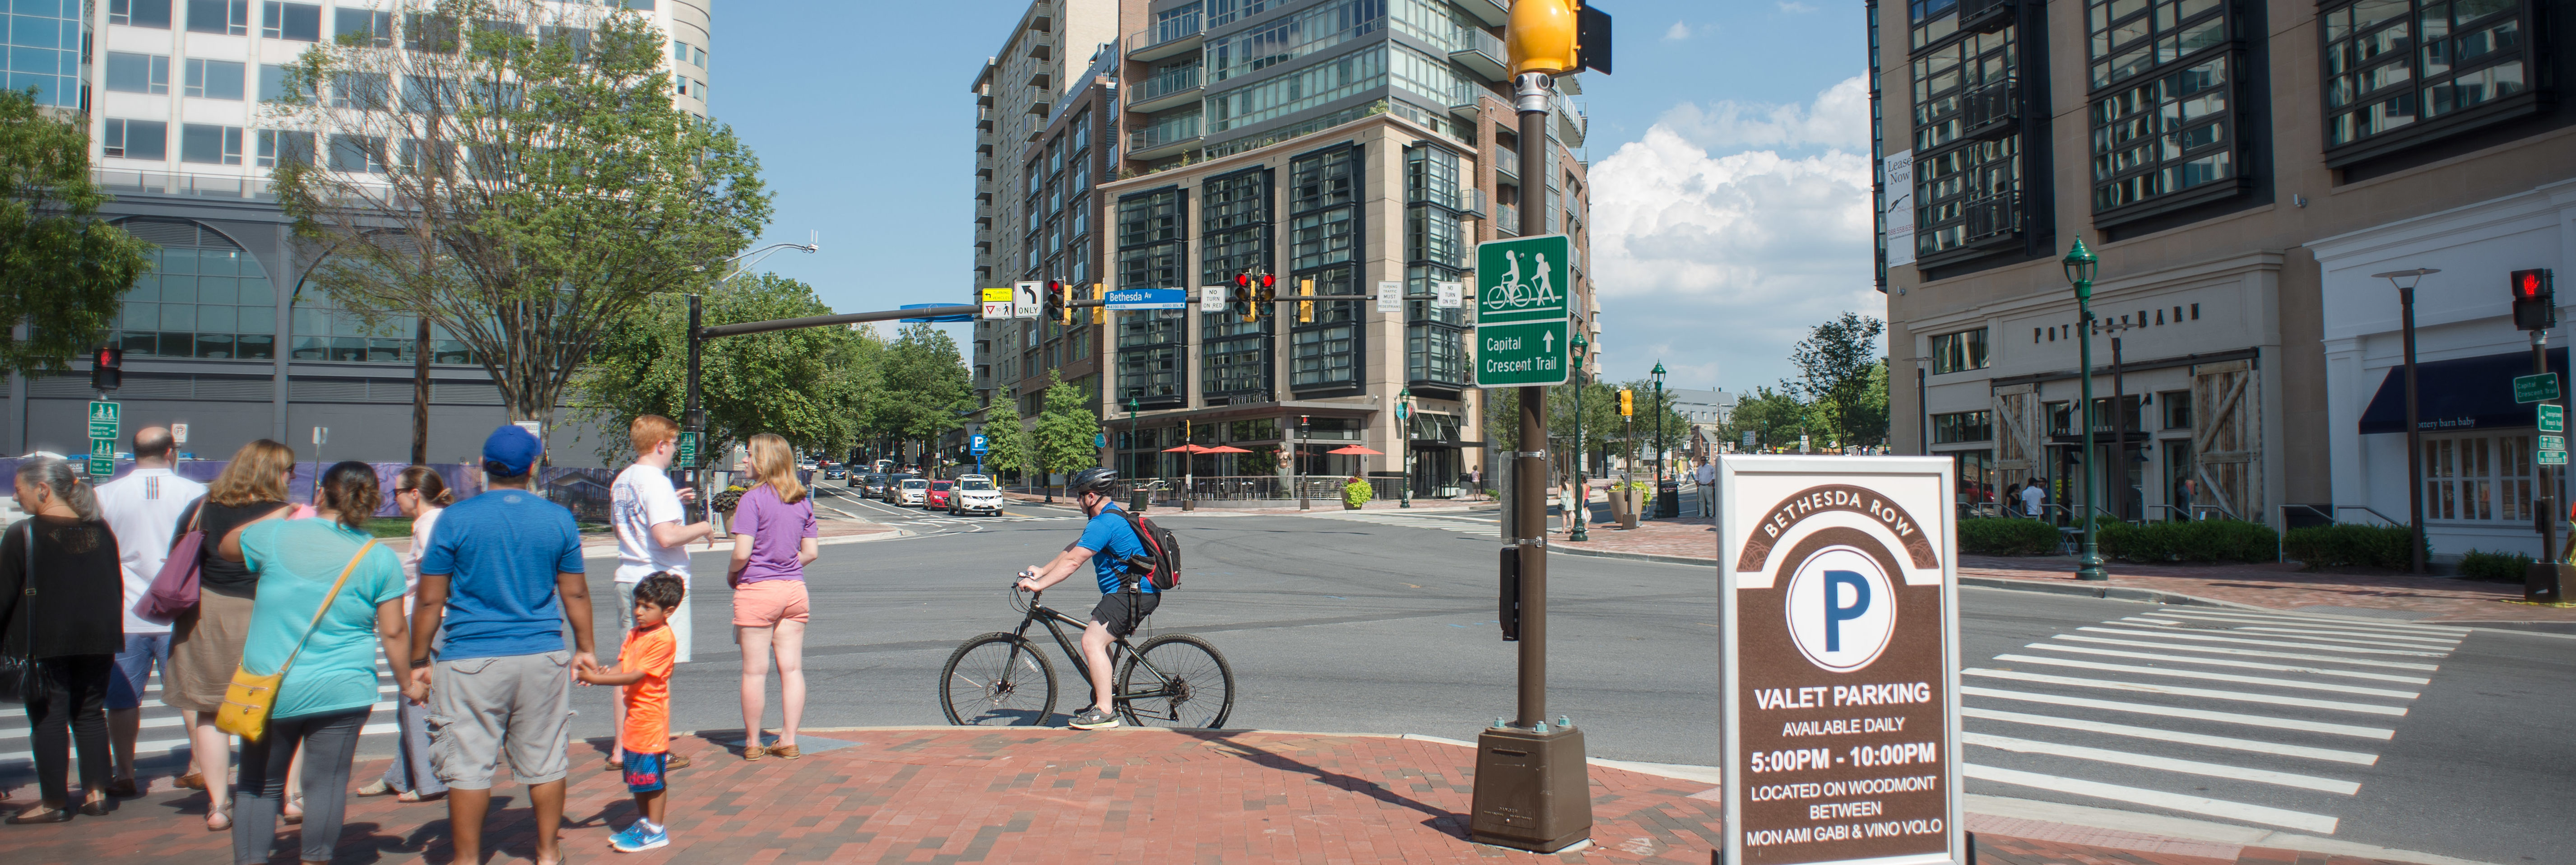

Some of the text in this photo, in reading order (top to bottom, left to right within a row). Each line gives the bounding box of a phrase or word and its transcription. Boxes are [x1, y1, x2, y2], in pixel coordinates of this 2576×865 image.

[1888, 157, 1912, 172] Lease
[1890, 172, 1910, 185] Now
[1888, 223, 1914, 236] 888.558.639
[1109, 292, 1142, 302] Bethesda
[2137, 303, 2200, 328] BARN
[1487, 336, 1521, 354] Capital
[1487, 356, 1557, 373] Crescent Trail
[2439, 418, 2455, 427] barn
[2457, 416, 2476, 428] baby
[975, 436, 984, 448] P
[1764, 491, 1915, 538] BETHESDA ROW
[1823, 570, 1871, 652] P
[1754, 682, 1931, 710] VALET PARKING
[1782, 717, 1905, 737] AVAILABLE DAILY
[1751, 748, 1830, 773] 5:00PM
[1850, 742, 1936, 767] 10:00PM
[1751, 776, 1937, 801] LOCATED ON WOODMONT
[1810, 801, 1882, 819] BETWEEN
[1747, 818, 1943, 846] MON AMI GABI & VINO VOLO
